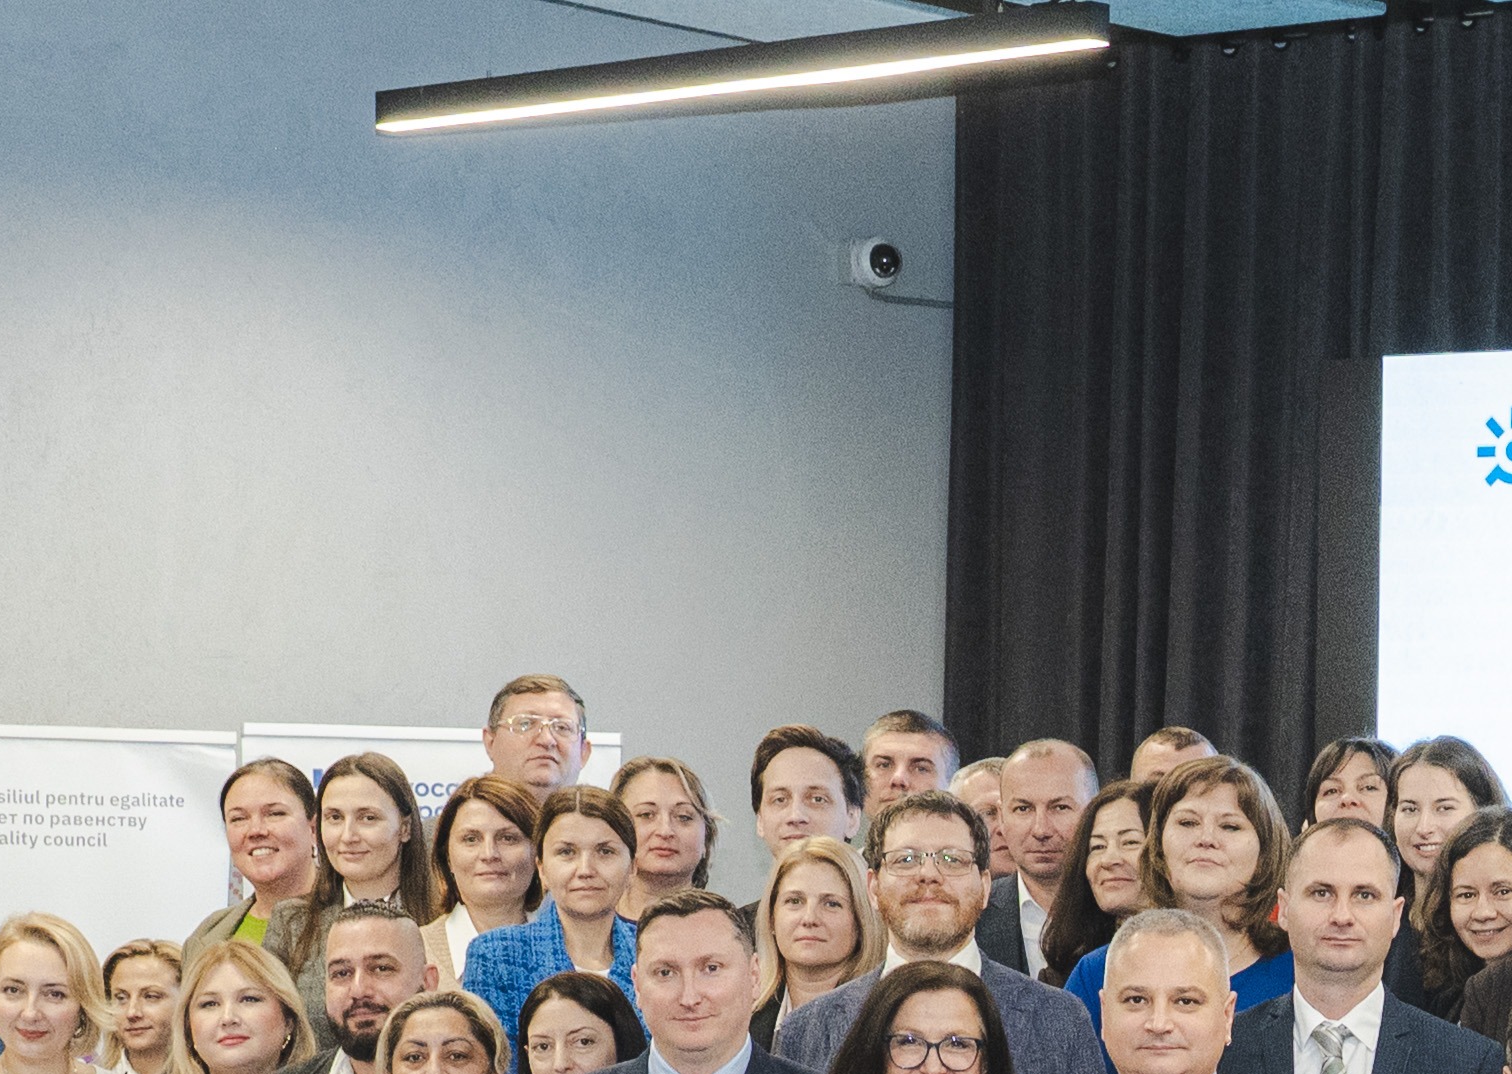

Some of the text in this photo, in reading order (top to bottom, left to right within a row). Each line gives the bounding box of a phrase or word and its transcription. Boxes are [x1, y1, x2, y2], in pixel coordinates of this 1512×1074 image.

[45, 791, 105, 808] pentru
[109, 793, 186, 810] egalitate
[23, 813, 45, 825] по
[49, 813, 148, 831] равенству
[43, 832, 108, 848] council
